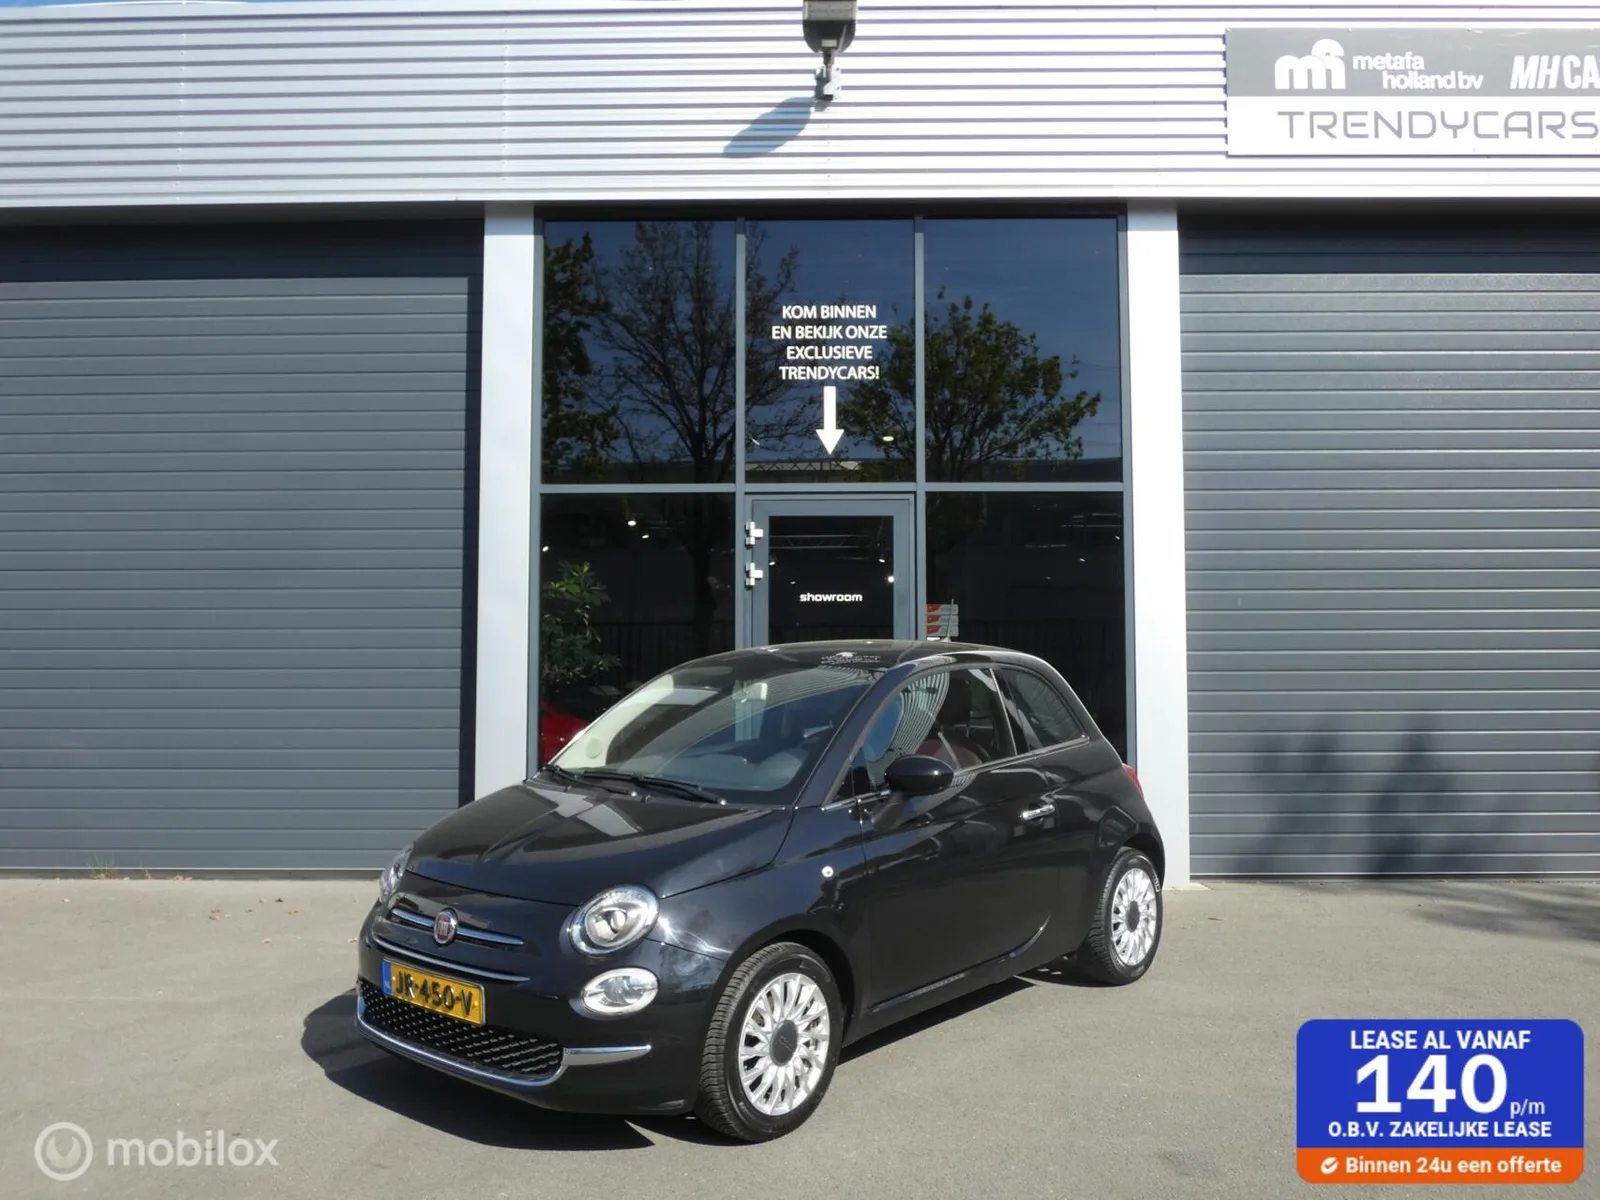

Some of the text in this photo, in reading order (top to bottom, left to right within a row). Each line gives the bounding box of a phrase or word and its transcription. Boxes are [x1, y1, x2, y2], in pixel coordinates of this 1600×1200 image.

[1352, 51, 1425, 70] metafa
[1382, 70, 1484, 90] holland bv
[1277, 110, 1599, 139] TRENDYCARS
[782, 305, 877, 319] KOM BINNEN
[771, 325, 888, 340] EN BEKIJK ONZE
[786, 345, 873, 360] EXCLUSIEVE
[779, 366, 880, 380] TRENDYCARS!
[799, 592, 863, 602] showroom
